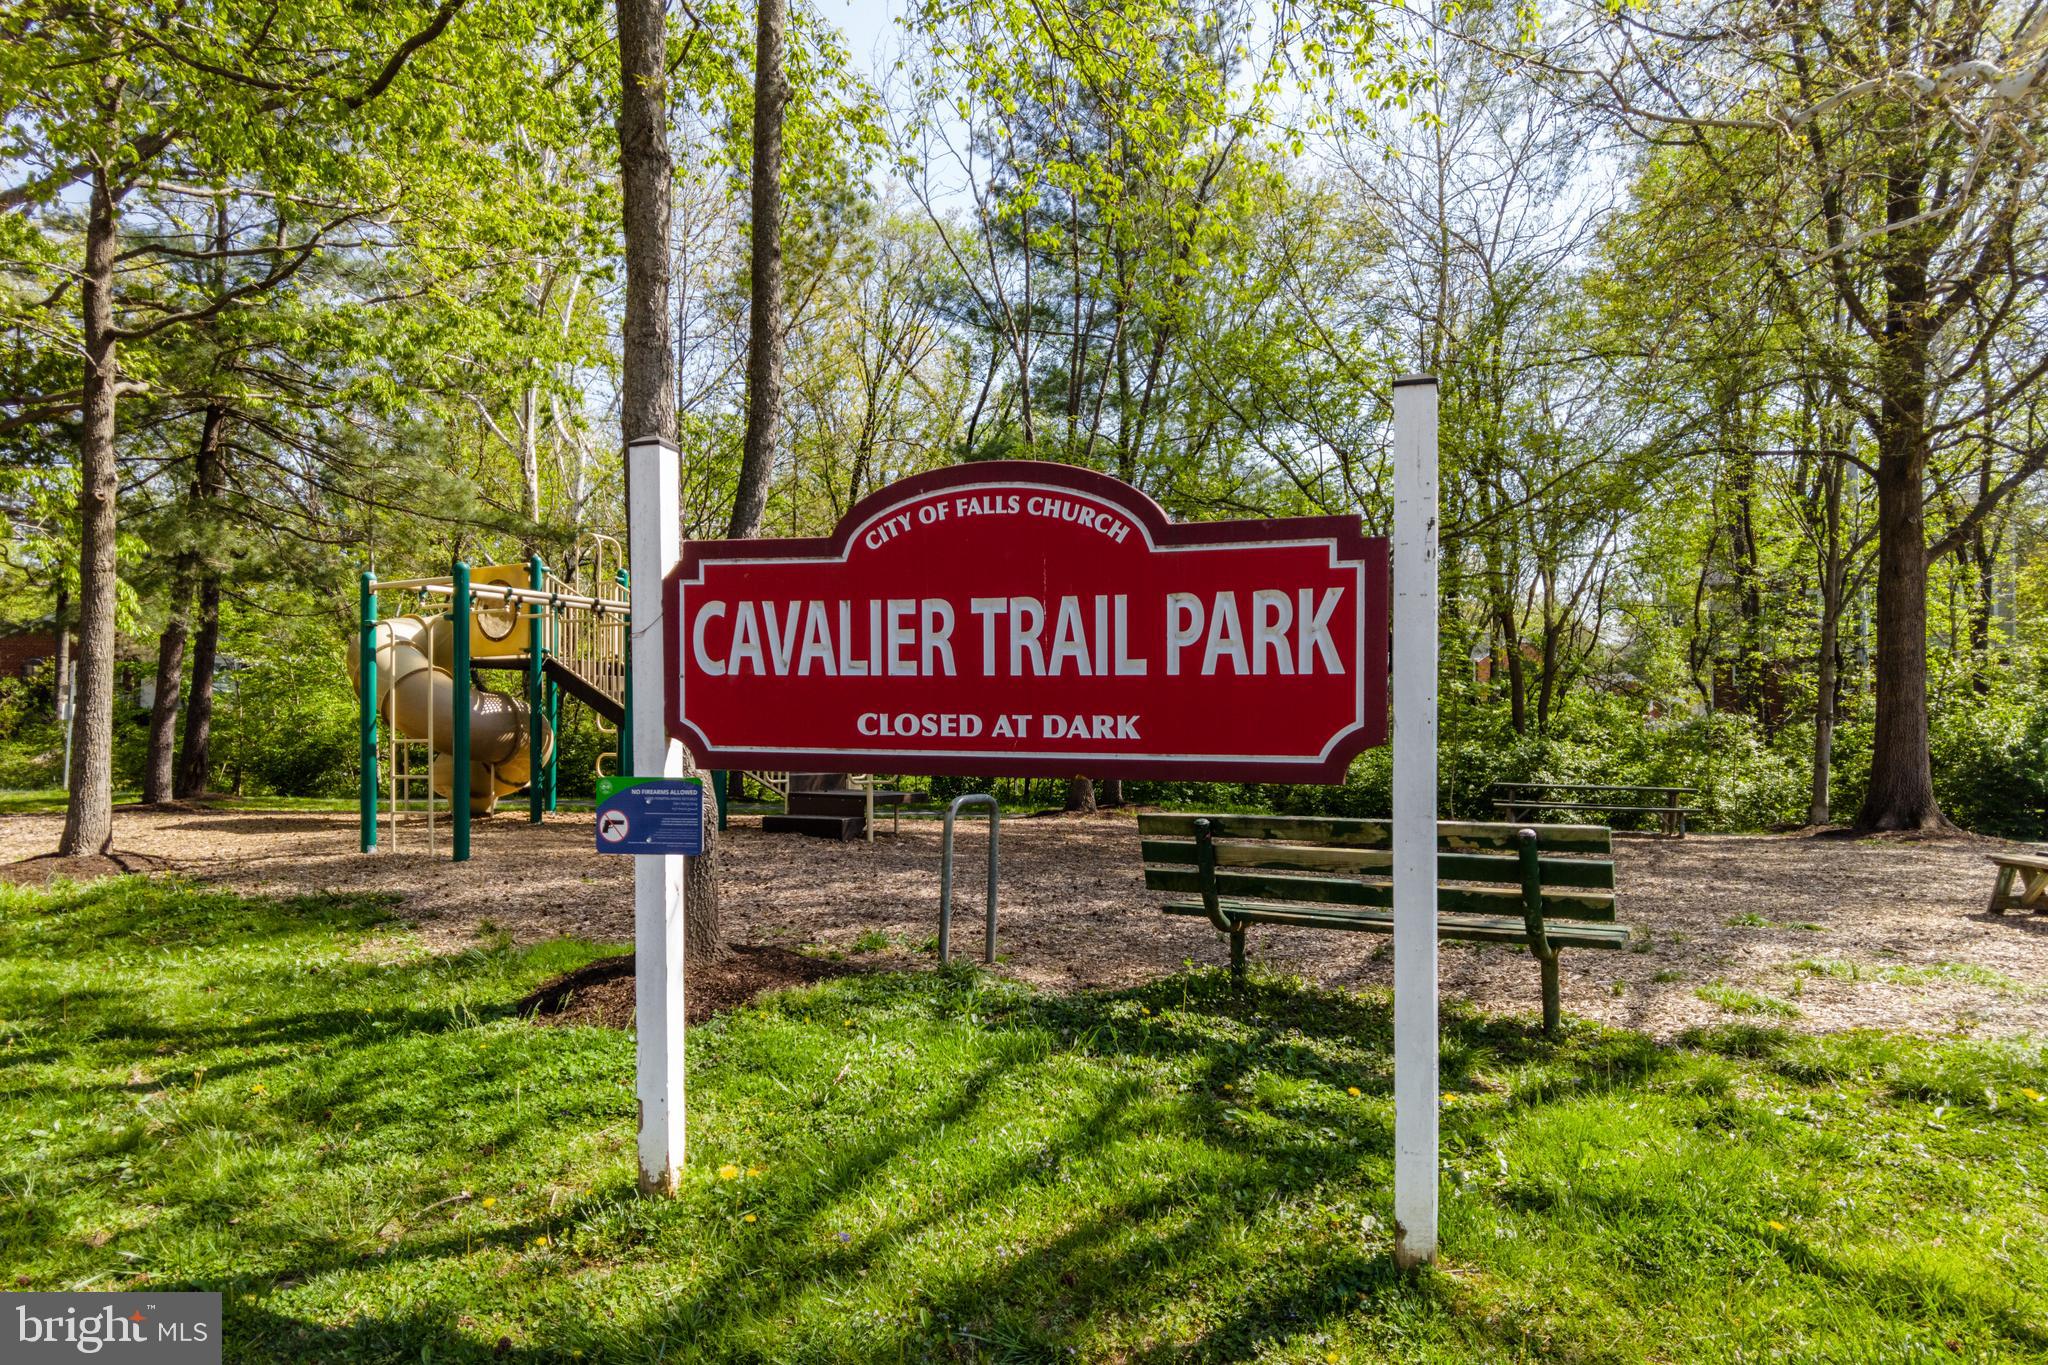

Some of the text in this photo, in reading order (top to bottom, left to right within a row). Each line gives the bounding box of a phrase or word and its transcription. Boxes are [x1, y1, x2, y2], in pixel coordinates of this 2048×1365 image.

[865, 495, 1131, 550] CITY OF FALLS CHURCH
[692, 586, 1346, 678] CAVALIER TRAIL PARK
[857, 712, 1141, 740] CLOSED AT DARK
